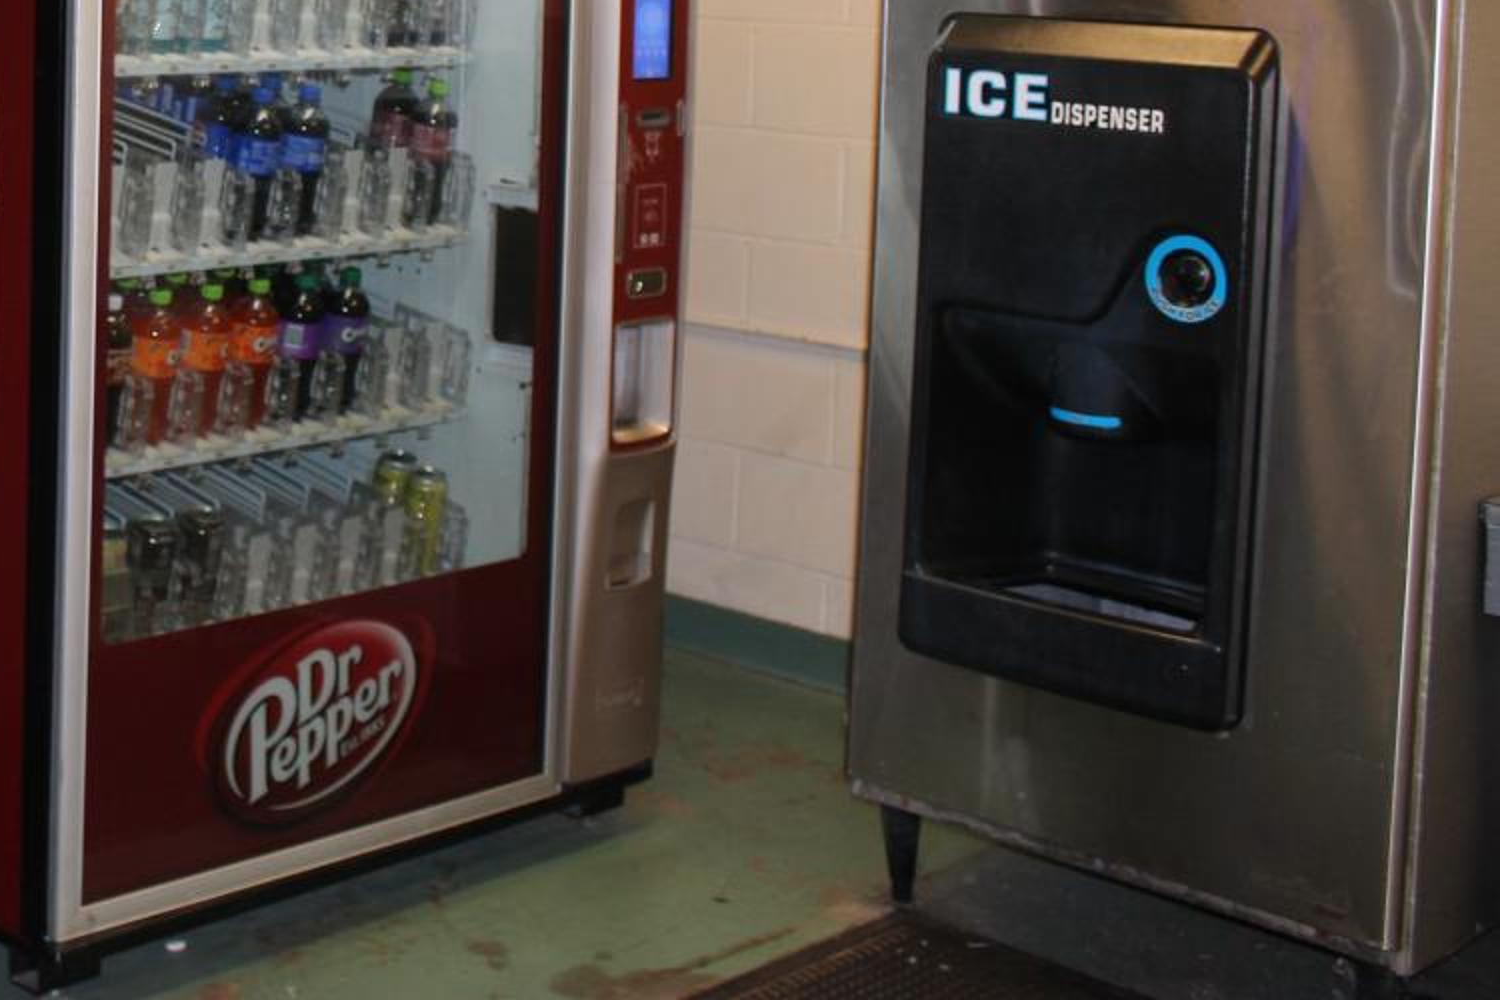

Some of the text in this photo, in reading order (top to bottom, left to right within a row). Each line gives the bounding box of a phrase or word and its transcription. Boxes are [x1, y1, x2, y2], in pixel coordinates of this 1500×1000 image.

[944, 67, 1165, 133] ICE DISPENSER
[297, 643, 363, 725] Dr
[226, 659, 401, 803] Pepper
